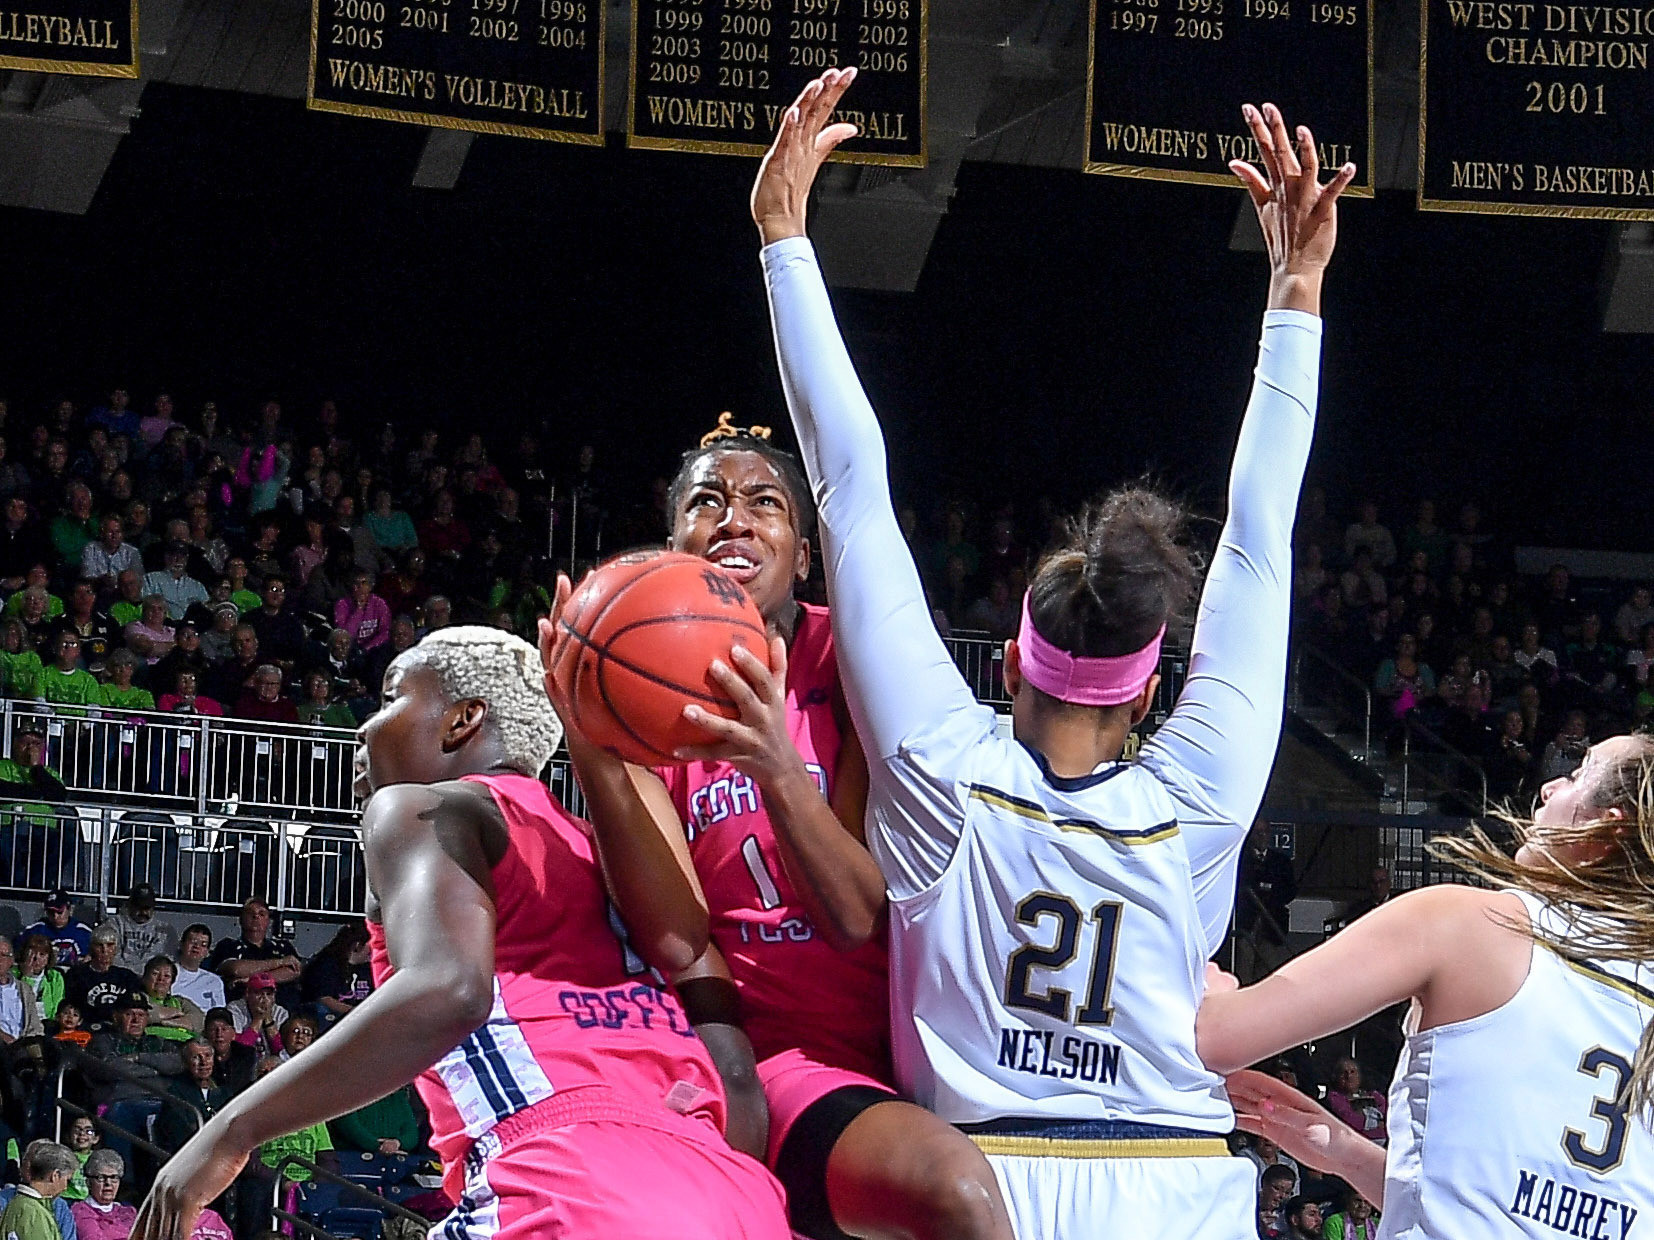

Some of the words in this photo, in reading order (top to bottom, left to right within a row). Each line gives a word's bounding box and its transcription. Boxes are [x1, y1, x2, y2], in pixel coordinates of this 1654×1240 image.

[334, 0, 385, 23] 2000
[400, 6, 447, 33] 2001
[469, 16, 519, 41] 2002
[539, 25, 585, 50] 2004
[540, 0, 586, 23] 1998
[655, 9, 703, 32] 1999
[720, 14, 771, 37] 2000
[789, 20, 837, 42] 2001
[858, 24, 908, 46] 2002
[861, 0, 909, 20] 1998
[1110, 10, 1158, 34] 1997
[1174, 17, 1224, 41] 2005
[1243, 0, 1291, 20] 1994
[1311, 3, 1357, 26] 1995
[1448, 0, 1535, 31] WEST
[331, 24, 383, 50] 2005
[651, 35, 701, 58] 2003
[719, 40, 769, 63] 2004
[789, 46, 838, 68] 2005
[858, 50, 908, 72] 2006
[1486, 36, 1649, 70] CHAMPION
[328, 58, 436, 100] WOMEN'S
[445, 74, 588, 119] VOLLEYBALL
[649, 61, 701, 85] 2009
[719, 66, 770, 90] 2012
[647, 95, 755, 131] WOMEN'S
[1525, 81, 1608, 115] 2001
[1102, 121, 1208, 160] WOMEN'S
[1451, 161, 1524, 191] MEN'S
[1534, 164, 1654, 197] BASKETBA
[1275, 834, 1291, 849] 12
[1003, 889, 1124, 1027] 21
[997, 1027, 1122, 1086] NELSON
[1560, 1043, 1637, 1176] 3
